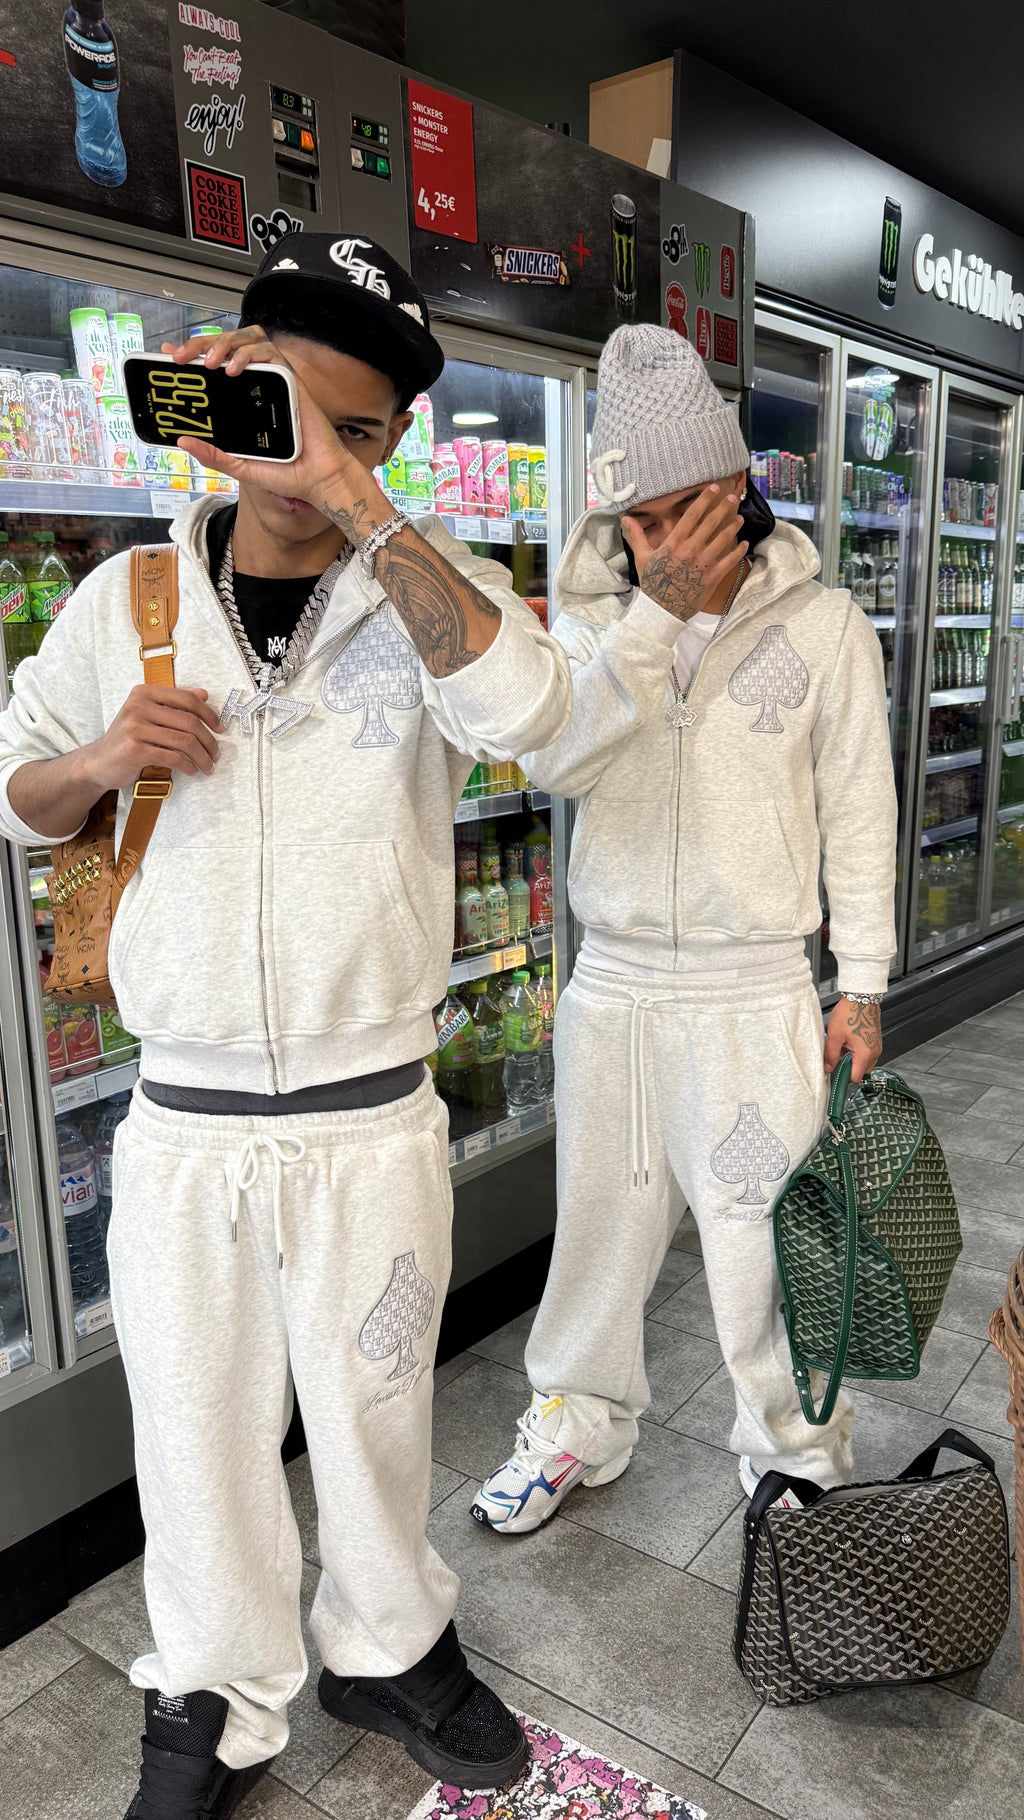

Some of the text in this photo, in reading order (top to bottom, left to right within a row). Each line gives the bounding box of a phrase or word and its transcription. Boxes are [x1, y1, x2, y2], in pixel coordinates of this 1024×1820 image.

[179, 4, 240, 41] ALWAYS COOL
[65, 33, 116, 64] POWERADE
[184, 46, 198, 71] You
[216, 51, 241, 65] Beat
[190, 65, 241, 88] The Feeling!
[412, 101, 444, 121] SNICKERS
[187, 95, 245, 154] enjoy!
[413, 127, 438, 143] ENERGY
[417, 116, 449, 135] MONSTER
[195, 175, 237, 198] COKE
[197, 190, 239, 213] COKE
[198, 204, 240, 226] COKE
[199, 218, 241, 240] COKE
[506, 249, 560, 277] SNICKERS
[913, 233, 1024, 332] Gekühlte
[148, 370, 215, 438] 12:58
[62, 1182, 95, 1205] vian
